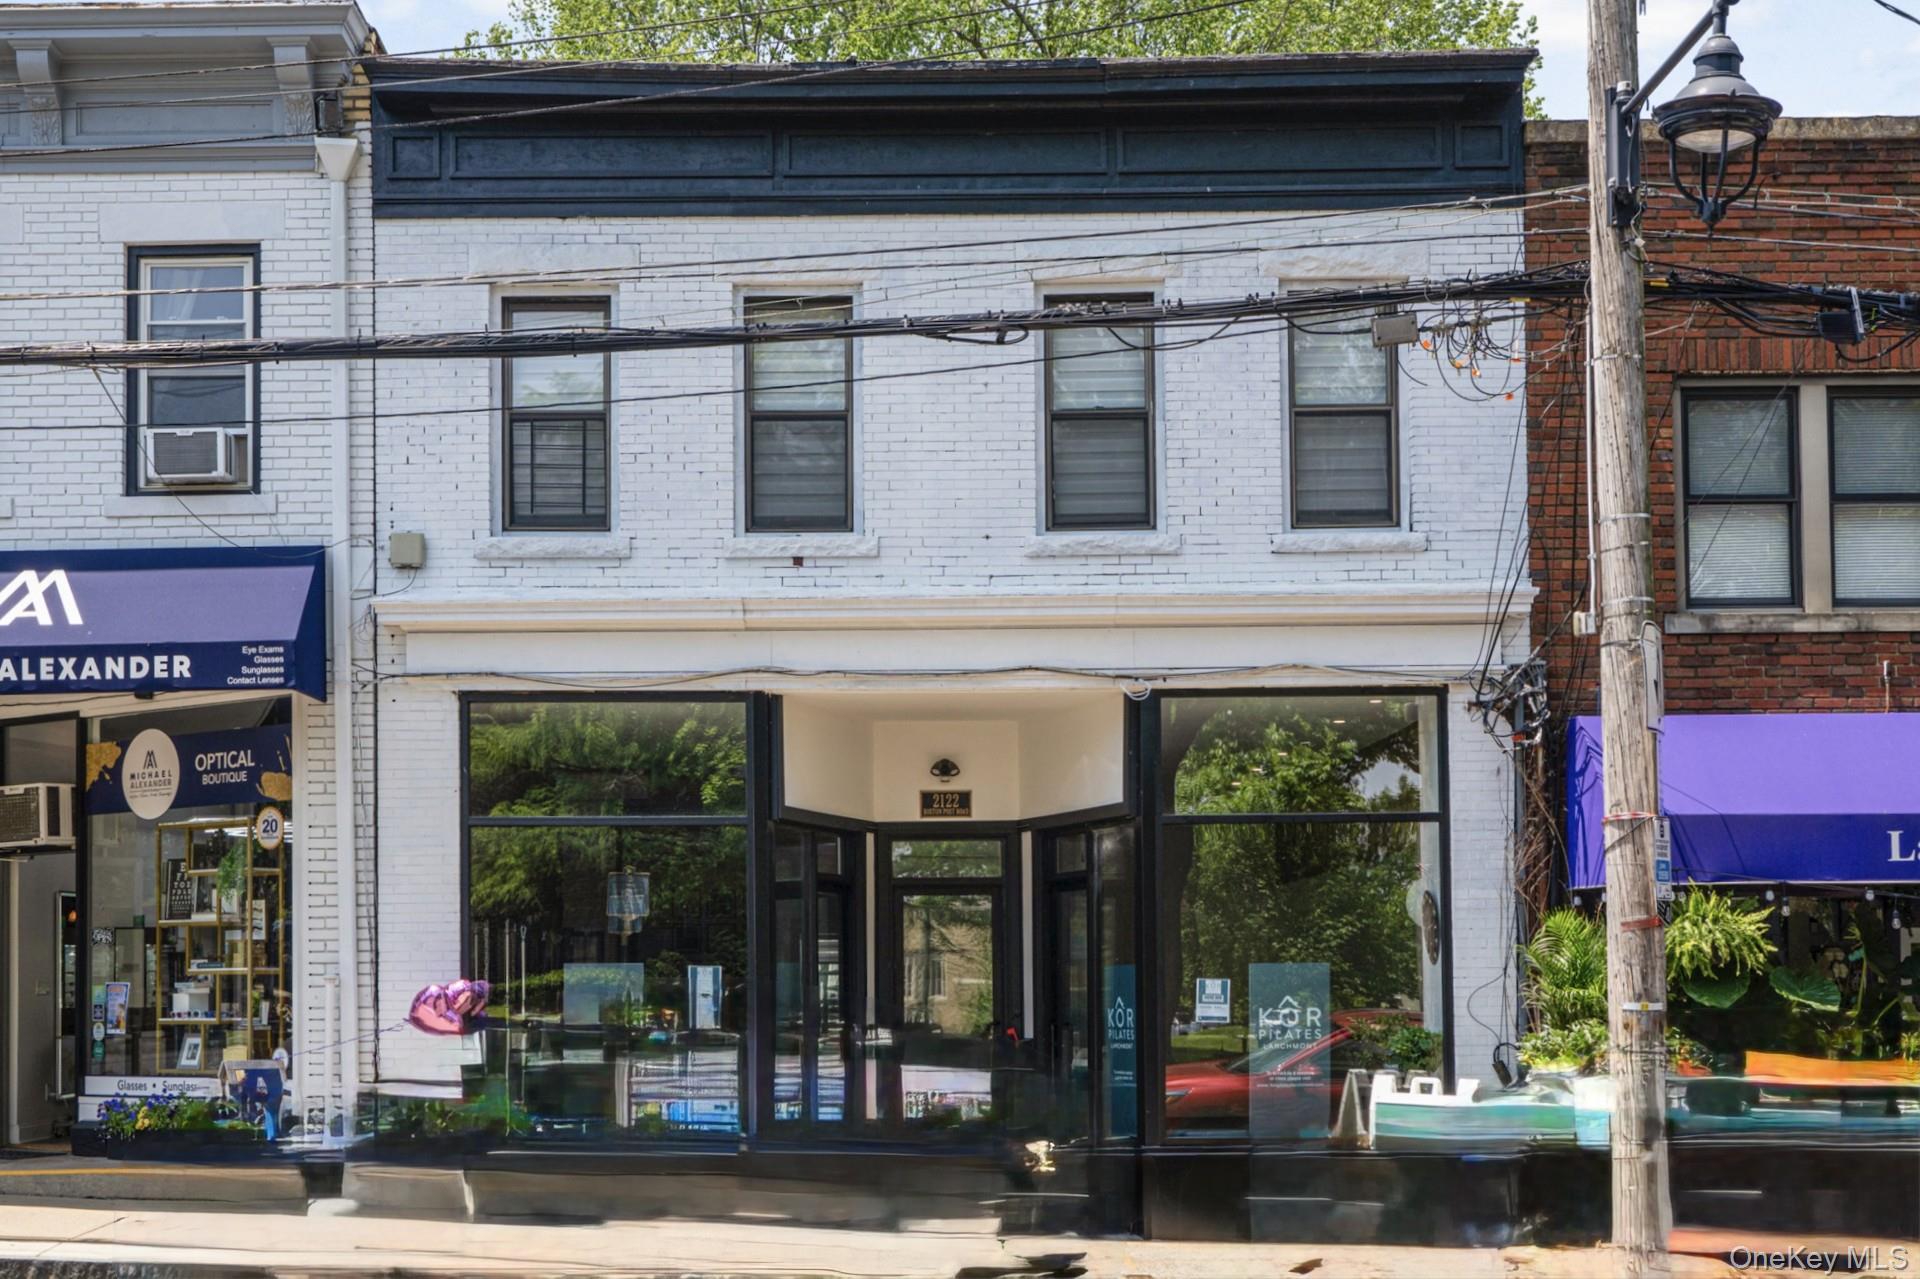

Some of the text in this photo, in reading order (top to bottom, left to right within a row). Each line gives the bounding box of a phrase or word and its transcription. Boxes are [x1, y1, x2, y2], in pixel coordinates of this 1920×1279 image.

[242, 645, 284, 655] Eye Exams
[254, 655, 284, 664] Glasses
[0, 655, 192, 681] ALEXANDER
[241, 666, 284, 675] Sunglasses
[227, 676, 285, 685] Contact Lenses
[195, 750, 255, 771] OPTICAL
[129, 772, 172, 780] MICHAEL
[202, 771, 247, 785] BOUTIQUE
[130, 779, 172, 789] ALEXANDER
[932, 793, 960, 808] 2122
[262, 819, 278, 833] 20
[1887, 830, 1920, 861] L
[1108, 1029, 1135, 1040] PILATES
[1258, 1029, 1322, 1040] PILATES
[117, 1079, 147, 1091] Glasses
